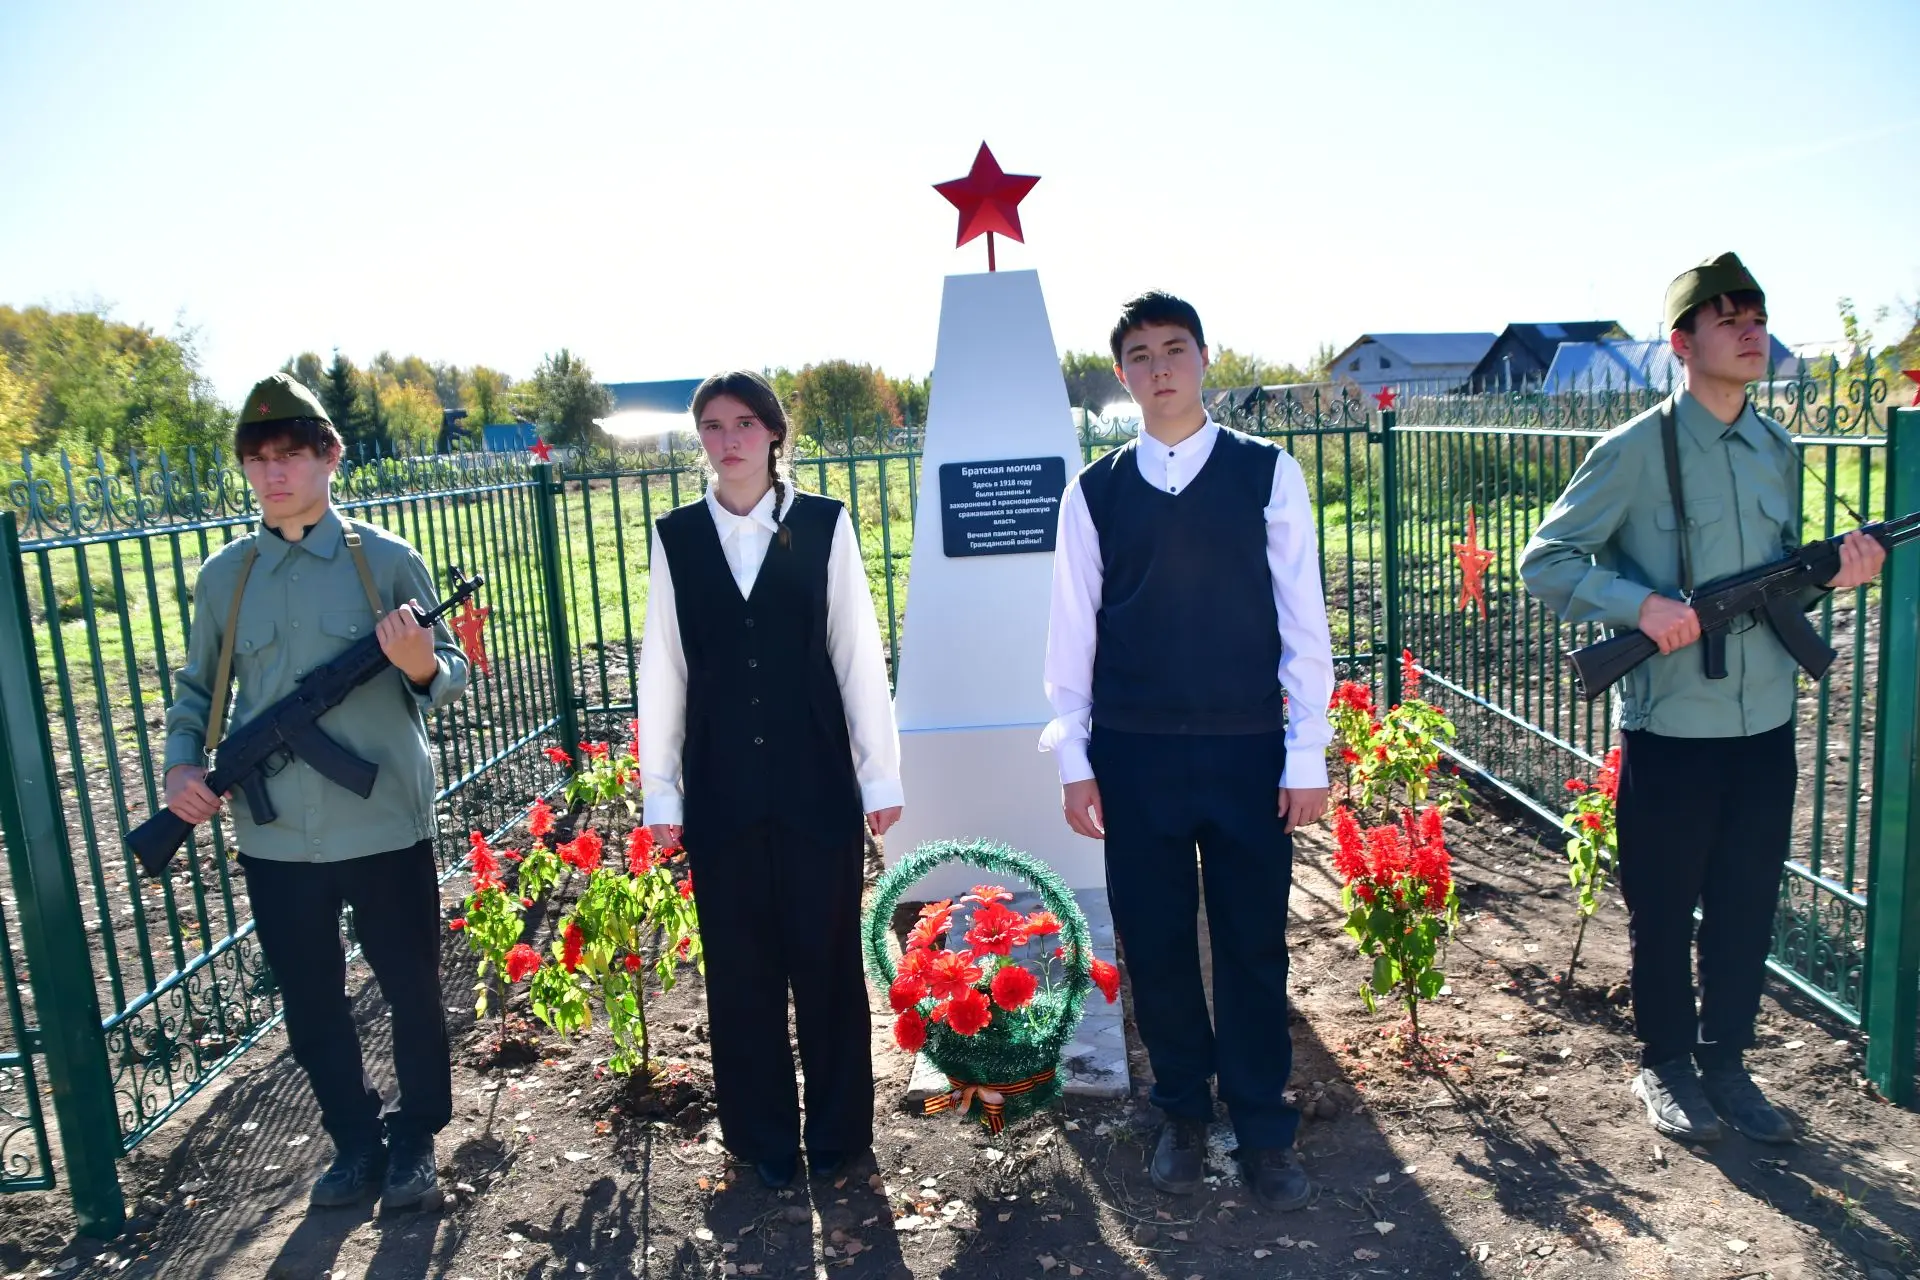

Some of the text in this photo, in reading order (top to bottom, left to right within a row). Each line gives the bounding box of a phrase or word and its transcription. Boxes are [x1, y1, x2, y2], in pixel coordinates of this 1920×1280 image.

[962, 463, 1041, 477] Братская могила
[958, 510, 1004, 519] сражавшихся
[1015, 506, 1050, 515] советскую
[1019, 529, 1044, 537] героям
[970, 537, 1042, 549] Гражданской войны!
